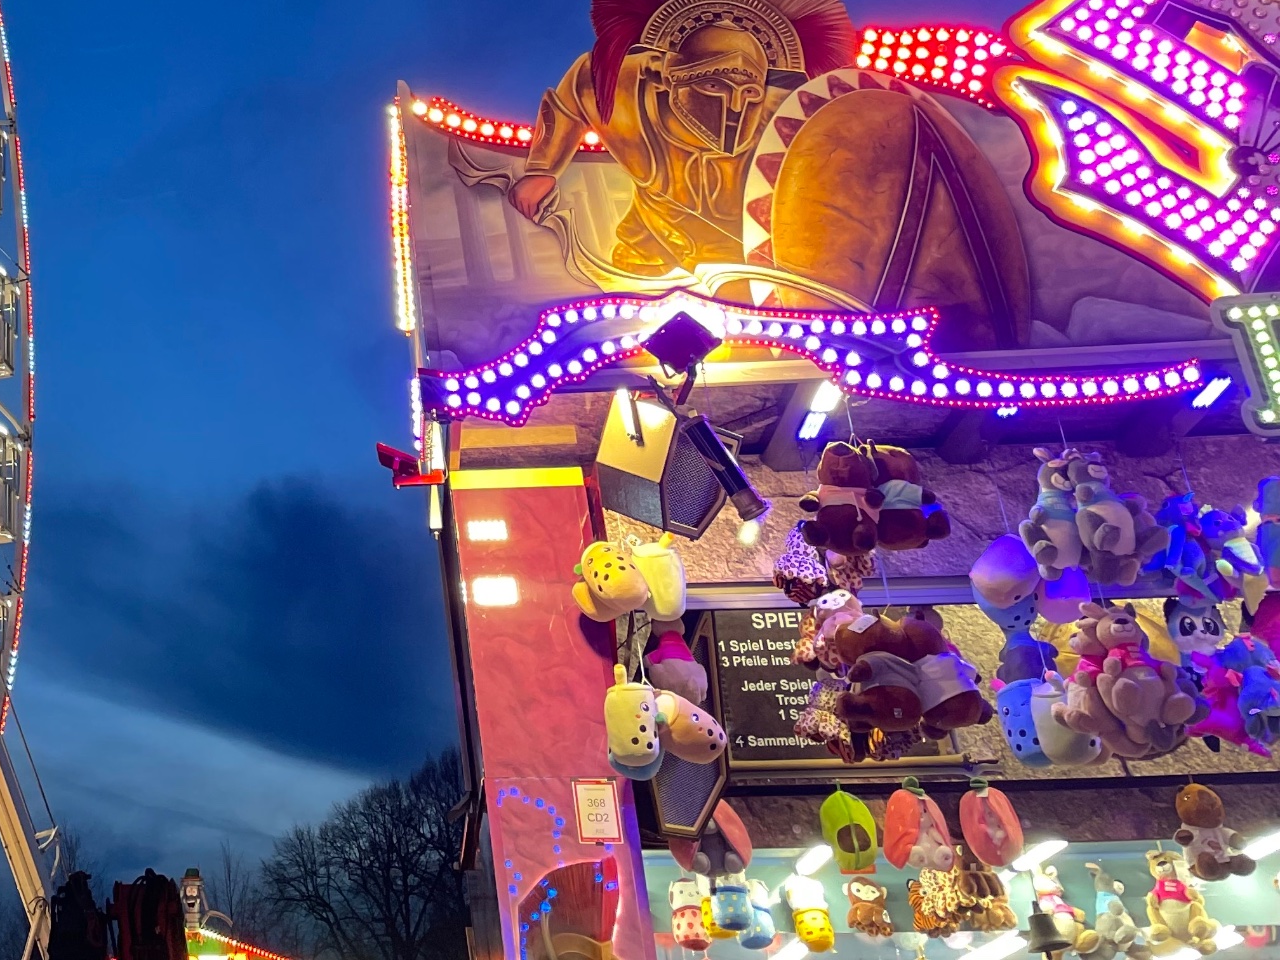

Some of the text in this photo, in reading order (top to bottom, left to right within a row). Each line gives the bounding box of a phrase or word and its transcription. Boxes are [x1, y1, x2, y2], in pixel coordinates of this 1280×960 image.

[718, 639, 799, 653] 1 Spiel best
[722, 655, 791, 667] 3 Pfeile ins
[741, 680, 777, 692] Jeder
[778, 709, 785, 721] 1
[735, 736, 744, 748] 4
[587, 798, 606, 808] 368
[587, 813, 610, 822] CD2
